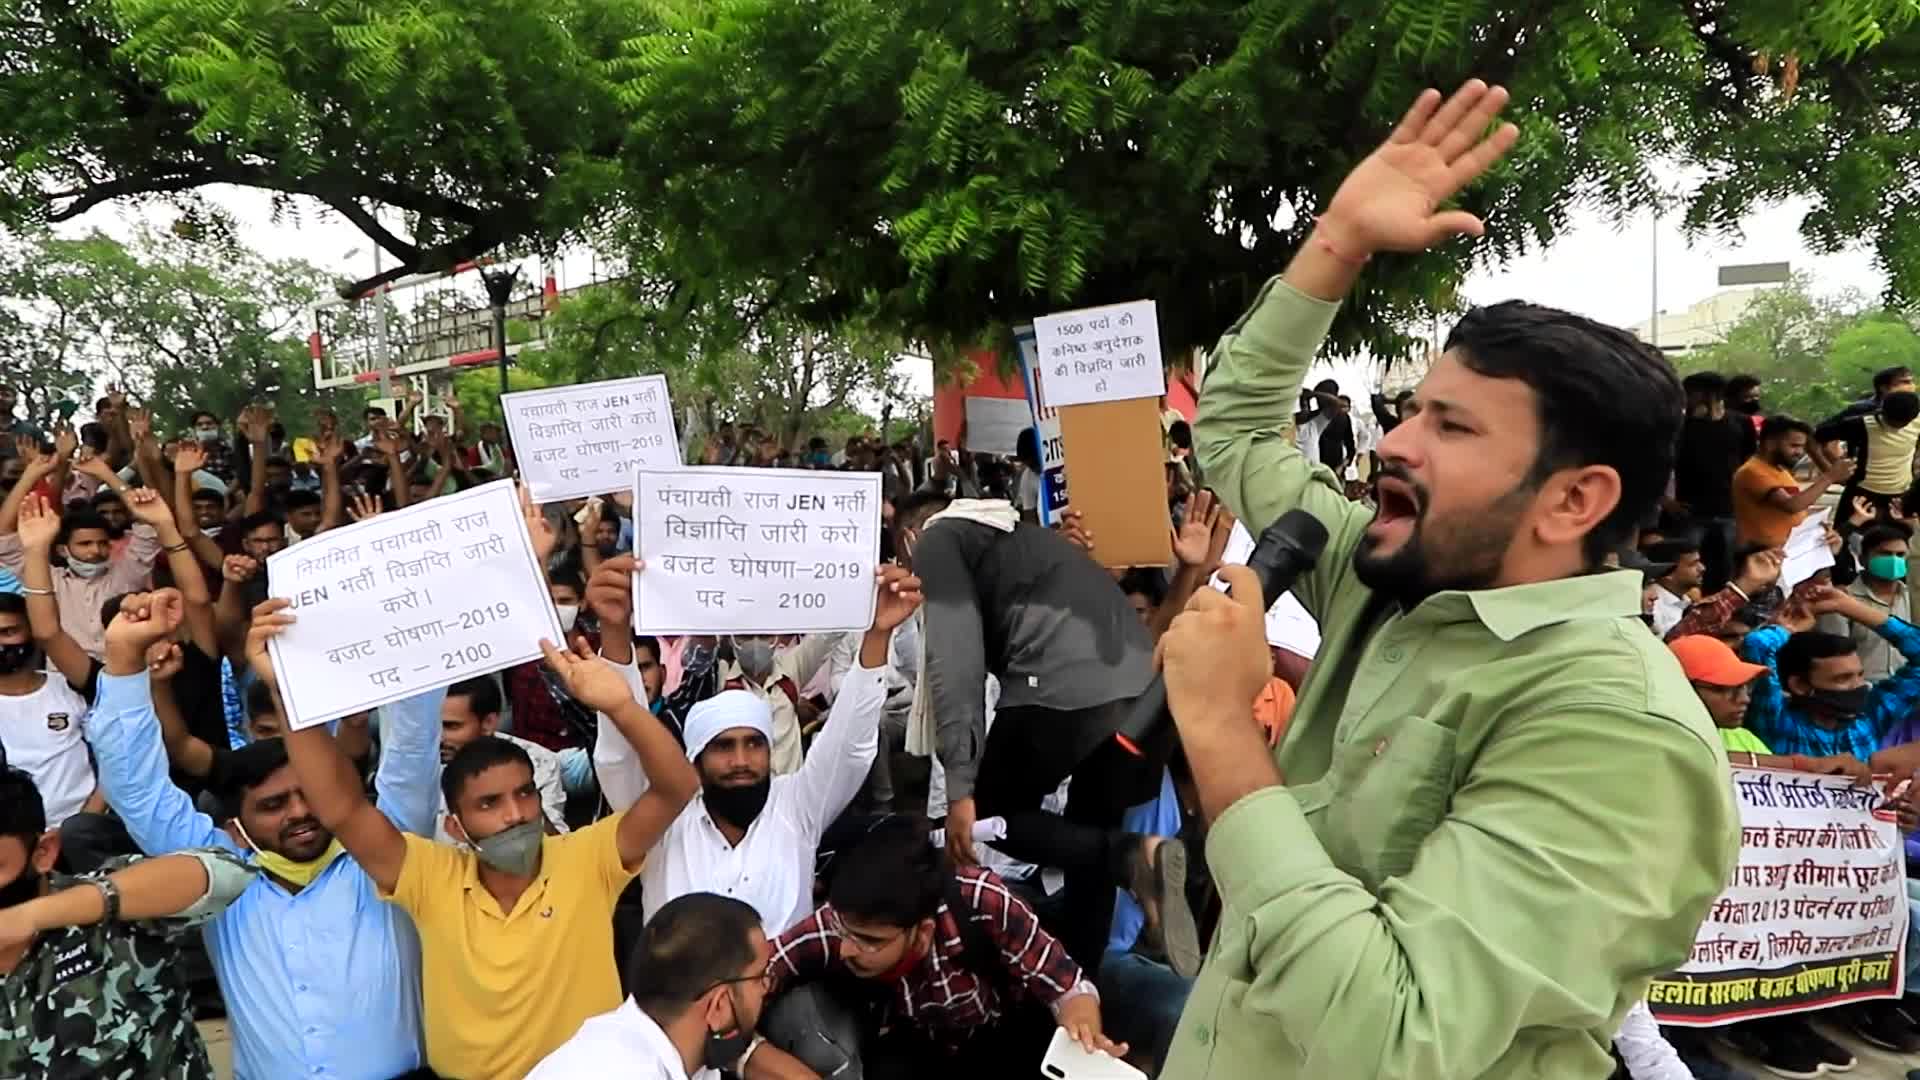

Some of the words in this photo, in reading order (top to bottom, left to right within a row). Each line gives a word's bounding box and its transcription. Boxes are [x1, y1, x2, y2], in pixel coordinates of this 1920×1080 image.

[1057, 324, 1083, 337] 1500
[1119, 312, 1133, 326] की
[1054, 364, 1069, 376] की
[1120, 352, 1146, 369] जारी
[1095, 379, 1107, 392] हो
[576, 399, 599, 413] राज
[603, 395, 629, 409] JEN
[592, 414, 622, 431] जारी
[631, 409, 656, 425] करो
[532, 447, 569, 463] बजट
[559, 467, 579, 480] पद
[657, 485, 731, 508] पंचायती
[744, 492, 780, 509] राज
[786, 495, 825, 511] JEN
[832, 489, 866, 513] भर्ती
[760, 519, 808, 544] जारी
[820, 519, 859, 544] करो
[296, 544, 360, 580] नियमित
[456, 510, 490, 534] राज
[289, 585, 329, 611] JEN
[337, 565, 376, 595] भर्ती
[463, 536, 506, 561] जारी
[662, 554, 715, 576] बजट
[696, 590, 727, 608] पद
[779, 593, 826, 609] 2100
[326, 639, 376, 665] बजट
[369, 666, 401, 689] पद
[441, 642, 493, 671] 2100
[1774, 820, 1816, 848] हेल्पर
[1743, 866, 1760, 887] पर
[1793, 858, 1835, 887] सीमा
[1852, 867, 1880, 893] छूट
[1752, 898, 1788, 922] 2013
[1834, 901, 1858, 919] पर
[1709, 979, 1757, 1004] सरकार
[1760, 976, 1796, 1000] बजट
